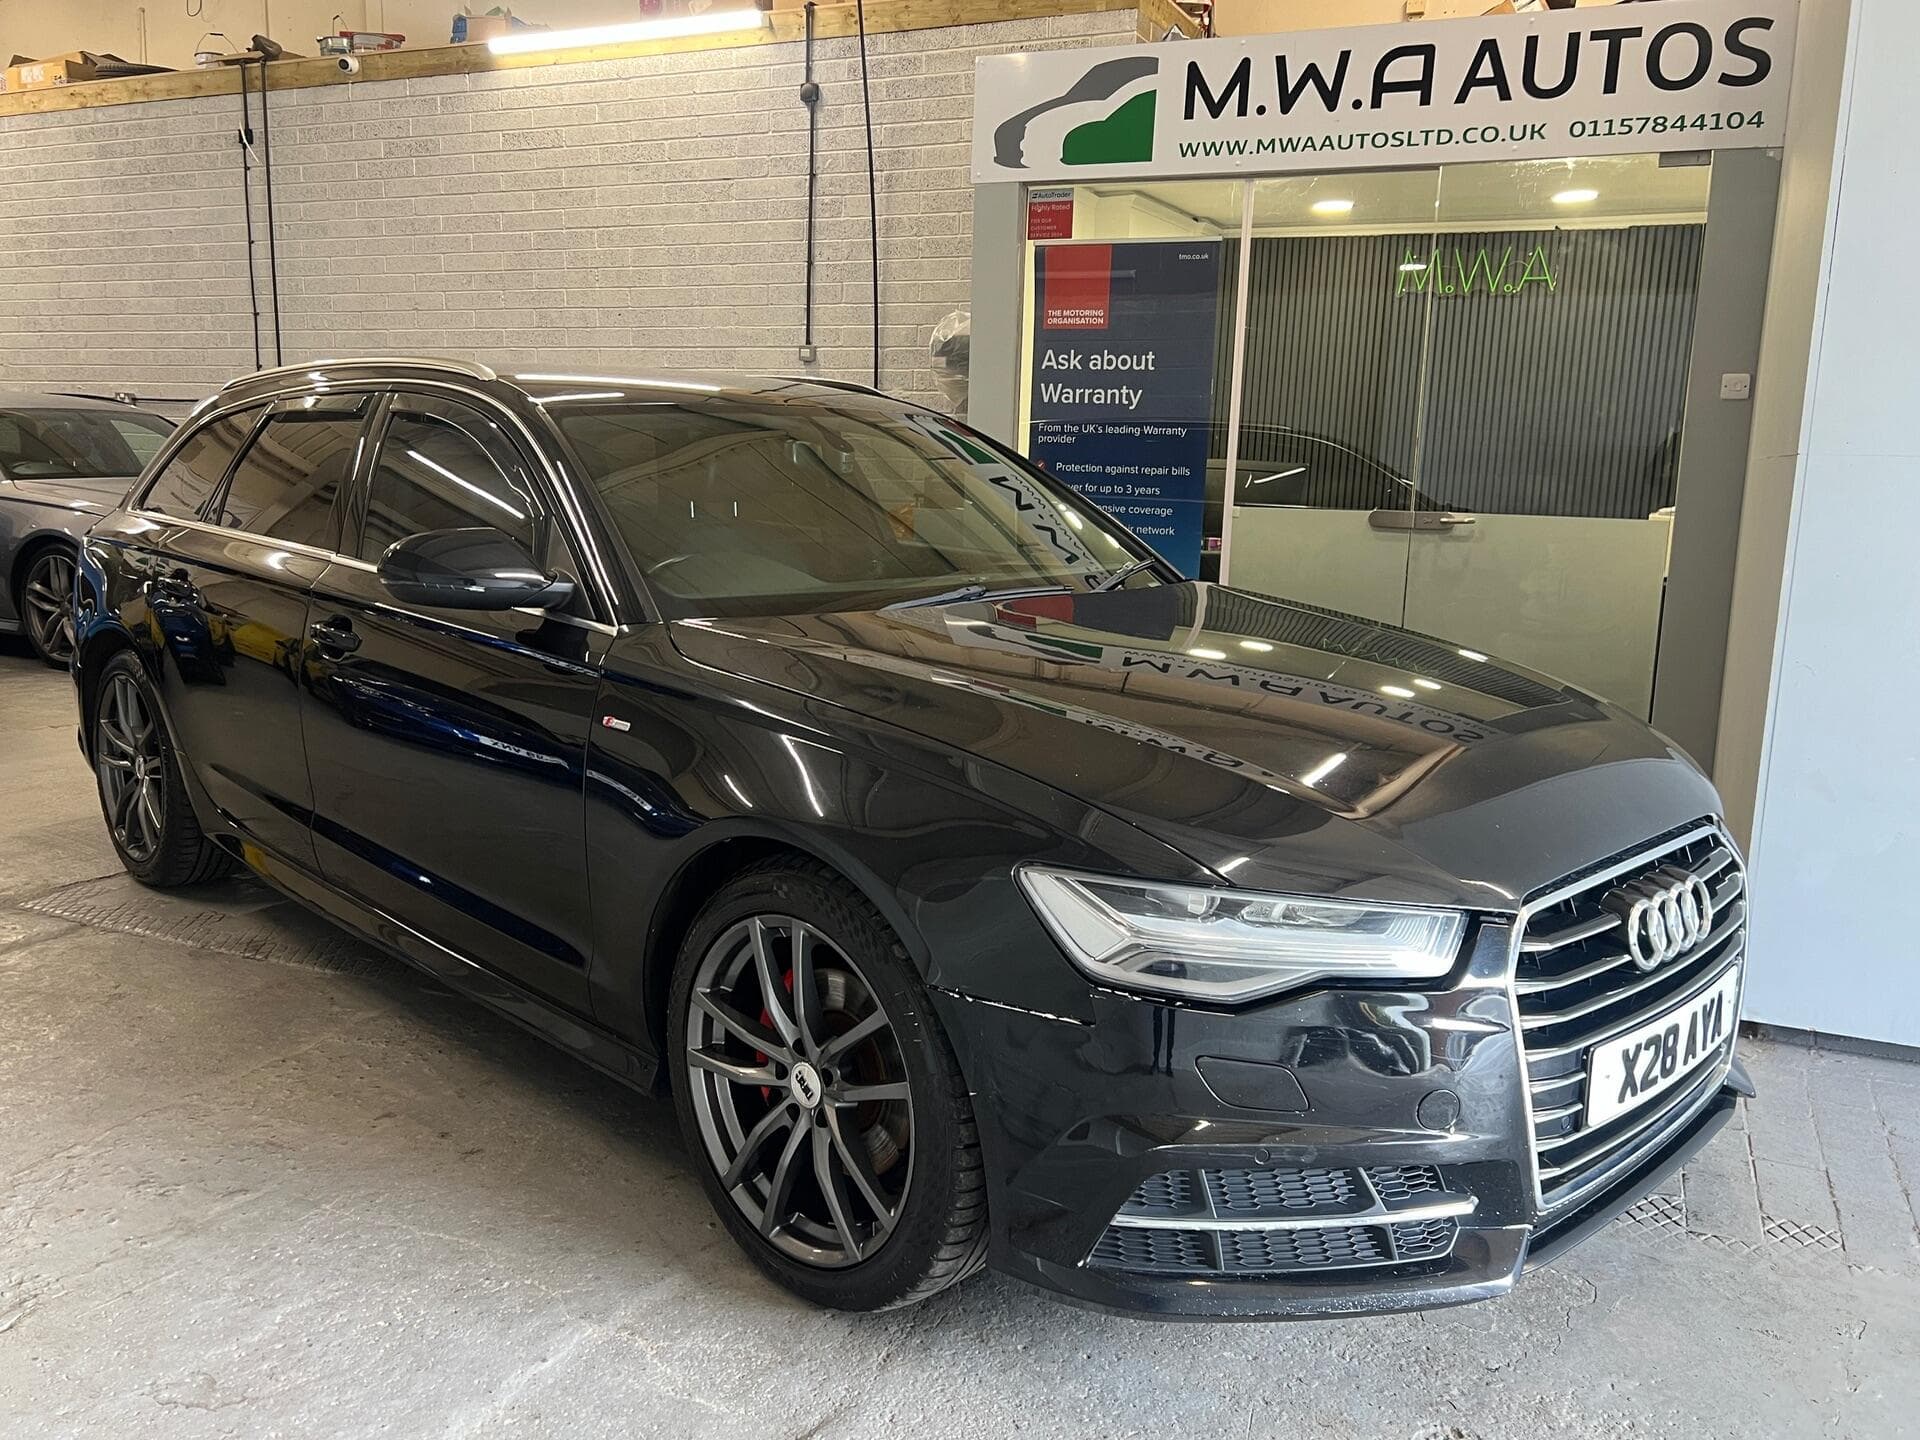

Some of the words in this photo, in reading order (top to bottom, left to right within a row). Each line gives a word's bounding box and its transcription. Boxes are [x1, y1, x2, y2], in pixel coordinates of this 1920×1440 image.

[1183, 43, 1437, 121] M.W.A
[1453, 16, 1775, 105] AUTOS
[1179, 122, 1547, 158] WWW.MWAAUTOSLTD.CO.UK
[1568, 110, 1765, 138] 01157844104
[1178, 252, 1209, 260] tmo.co.uk
[1047, 309, 1062, 317] THE
[1063, 309, 1104, 317] MOTORING
[1047, 317, 1104, 325] ORGANISATION
[1041, 349, 1083, 370] Ask
[1088, 349, 1155, 371] about
[1040, 382, 1143, 410] Warranty
[1038, 423, 1062, 433] From
[1063, 423, 1079, 433] the
[1081, 424, 1103, 434] UK's
[1105, 424, 1141, 437] leading
[1142, 425, 1188, 438] Warranty
[1038, 434, 1076, 444] provider
[1056, 462, 1103, 473] Protection
[1104, 464, 1139, 476] against
[1140, 465, 1169, 477] repair
[1171, 466, 1191, 477] bills
[1085, 483, 1098, 492] for
[1099, 485, 1112, 495] up
[1114, 484, 1124, 494] to
[1125, 484, 1132, 494] 3
[1134, 486, 1161, 496] years
[1128, 505, 1173, 518] coverage
[1136, 526, 1175, 536] network
[1617, 1022, 1680, 1104] X28
[1682, 989, 1724, 1066] AYA
